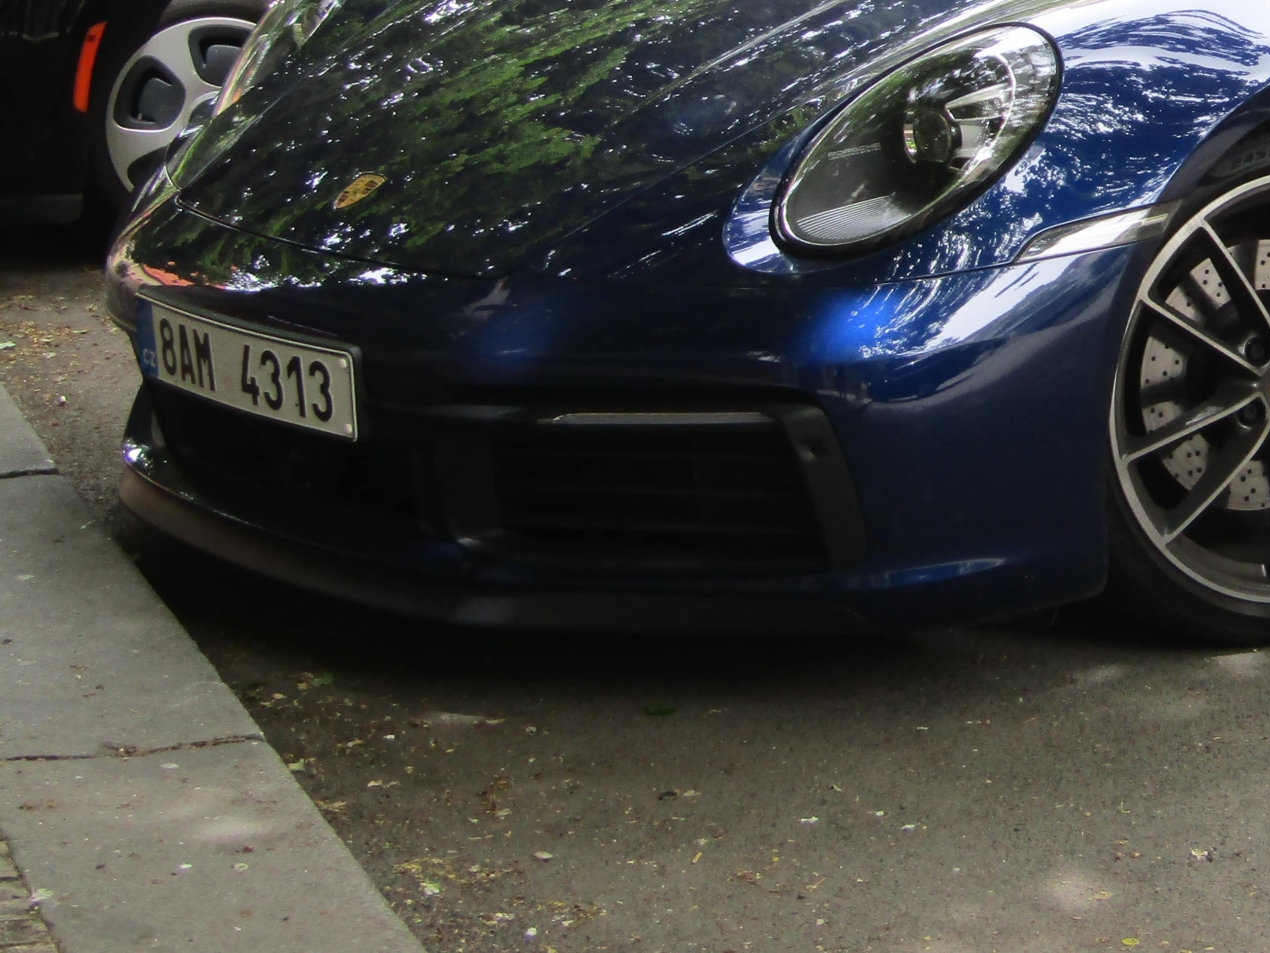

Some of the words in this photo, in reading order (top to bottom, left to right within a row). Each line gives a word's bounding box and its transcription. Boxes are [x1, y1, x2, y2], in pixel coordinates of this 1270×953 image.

[142, 348, 157, 368] CZ
[159, 317, 217, 392] 8AM
[241, 344, 334, 422] 4313
